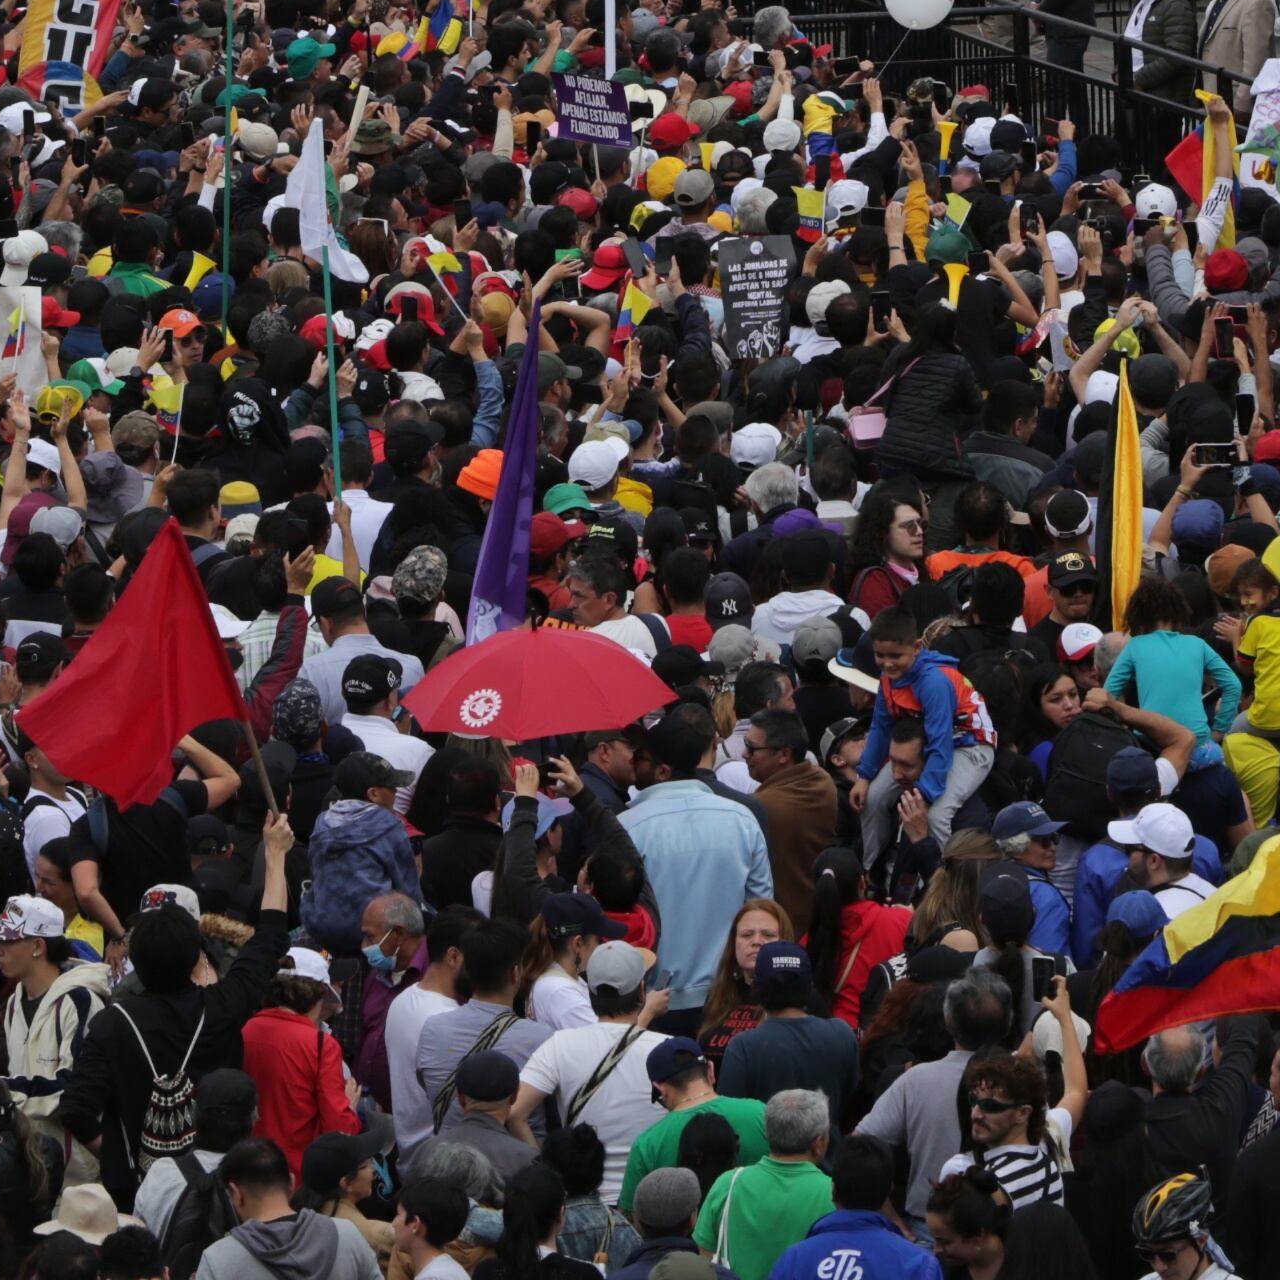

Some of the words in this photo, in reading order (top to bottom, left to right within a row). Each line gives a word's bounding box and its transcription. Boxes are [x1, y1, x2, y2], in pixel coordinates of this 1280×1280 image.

[564, 74, 576, 88] NO
[576, 75, 613, 94] PODEMOS
[561, 102, 589, 120] APENAS
[590, 107, 628, 125] ESTAMOS
[570, 119, 620, 140] FLORECIENDO
[728, 264, 741, 272] LAS
[743, 260, 778, 271] JORNADAS
[779, 259, 788, 267] DE
[748, 272, 757, 280] DE
[765, 269, 786, 279] HORAS
[728, 282, 759, 292] AFECTAN
[761, 281, 770, 289] TU
[722, 599, 738, 615] NY
[772, 956, 800, 964] YANKEES
